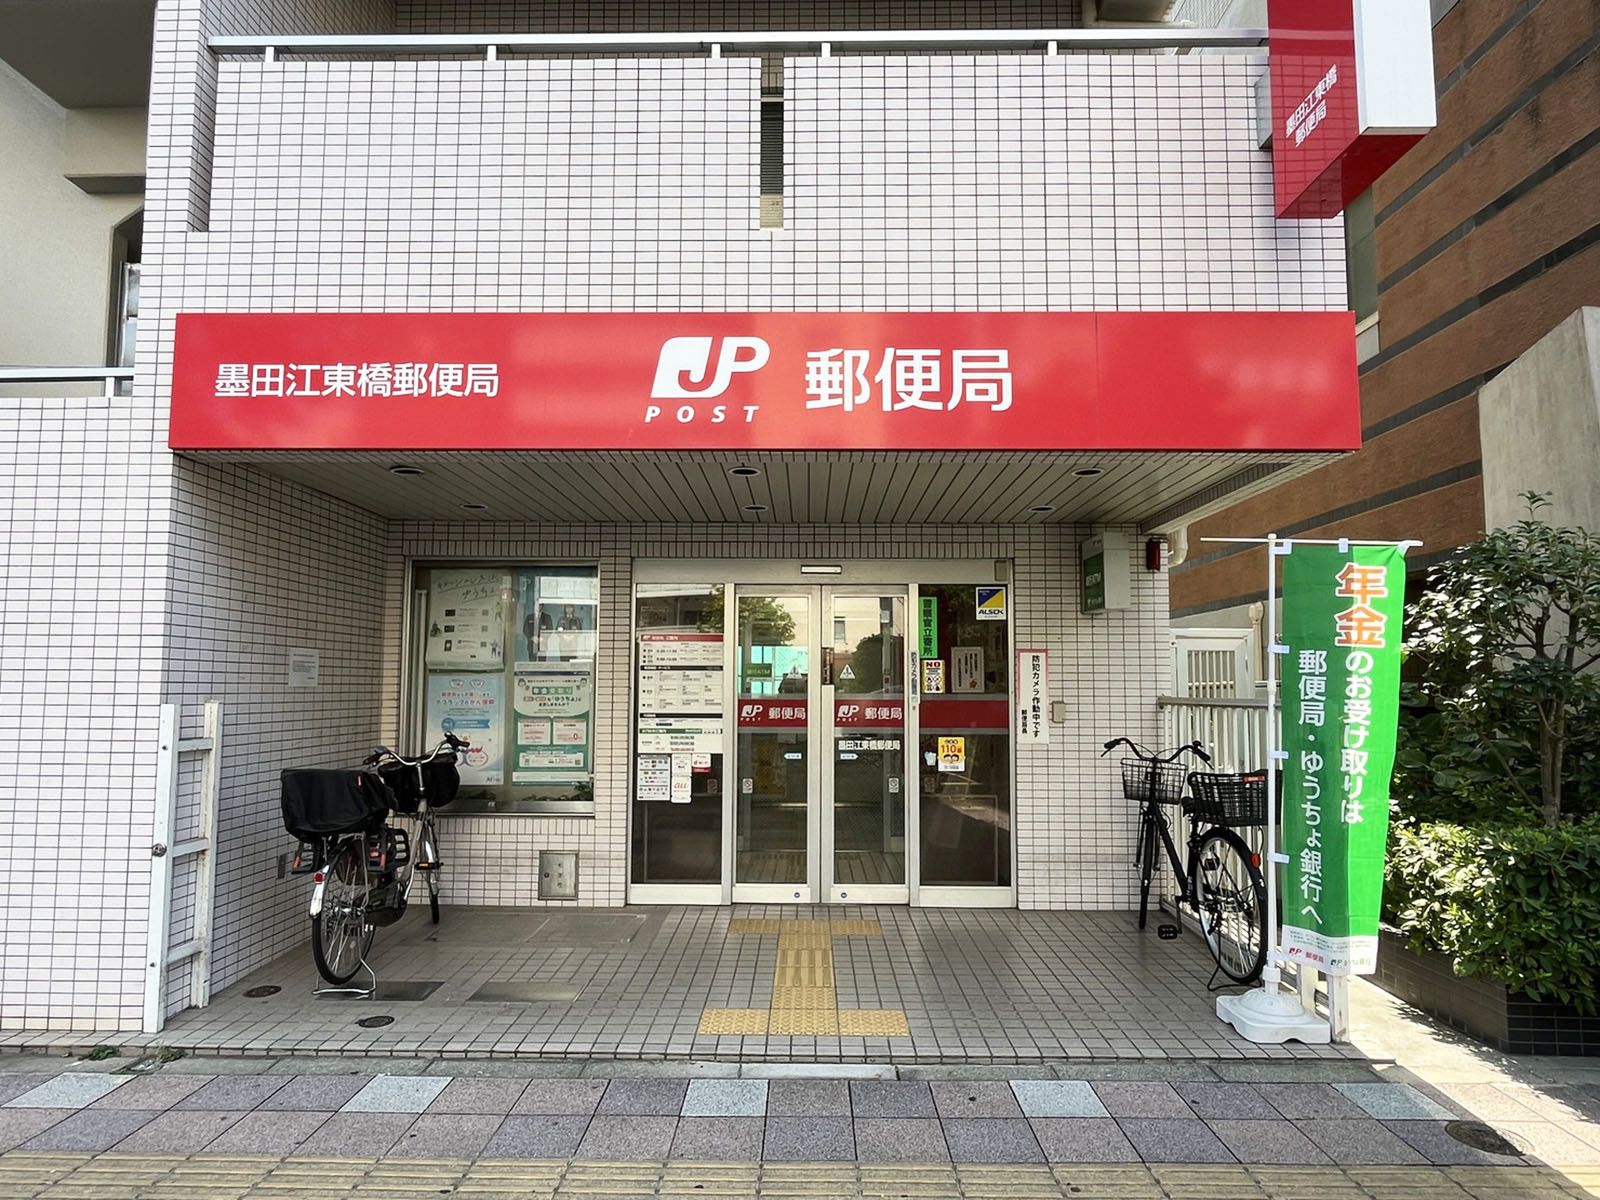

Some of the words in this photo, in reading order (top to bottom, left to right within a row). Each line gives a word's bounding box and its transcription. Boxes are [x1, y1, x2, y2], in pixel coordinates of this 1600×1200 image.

[1295, 99, 1327, 148] 郵便局
[214, 362, 499, 398] 墨田江東橋郵便局
[650, 336, 770, 398] JP
[805, 347, 1013, 412] 郵便局
[644, 405, 759, 424] POST
[741, 704, 763, 717] JP
[768, 707, 806, 720] 郵便局
[837, 704, 859, 717] JP
[865, 707, 902, 720] 郵便局
[1031, 655, 1041, 738] 防犯カメラ作動中です
[1334, 561, 1389, 826] 年金のお受け取りは
[1297, 649, 1328, 925] 郵便局・ゆうちょ銀行へ
